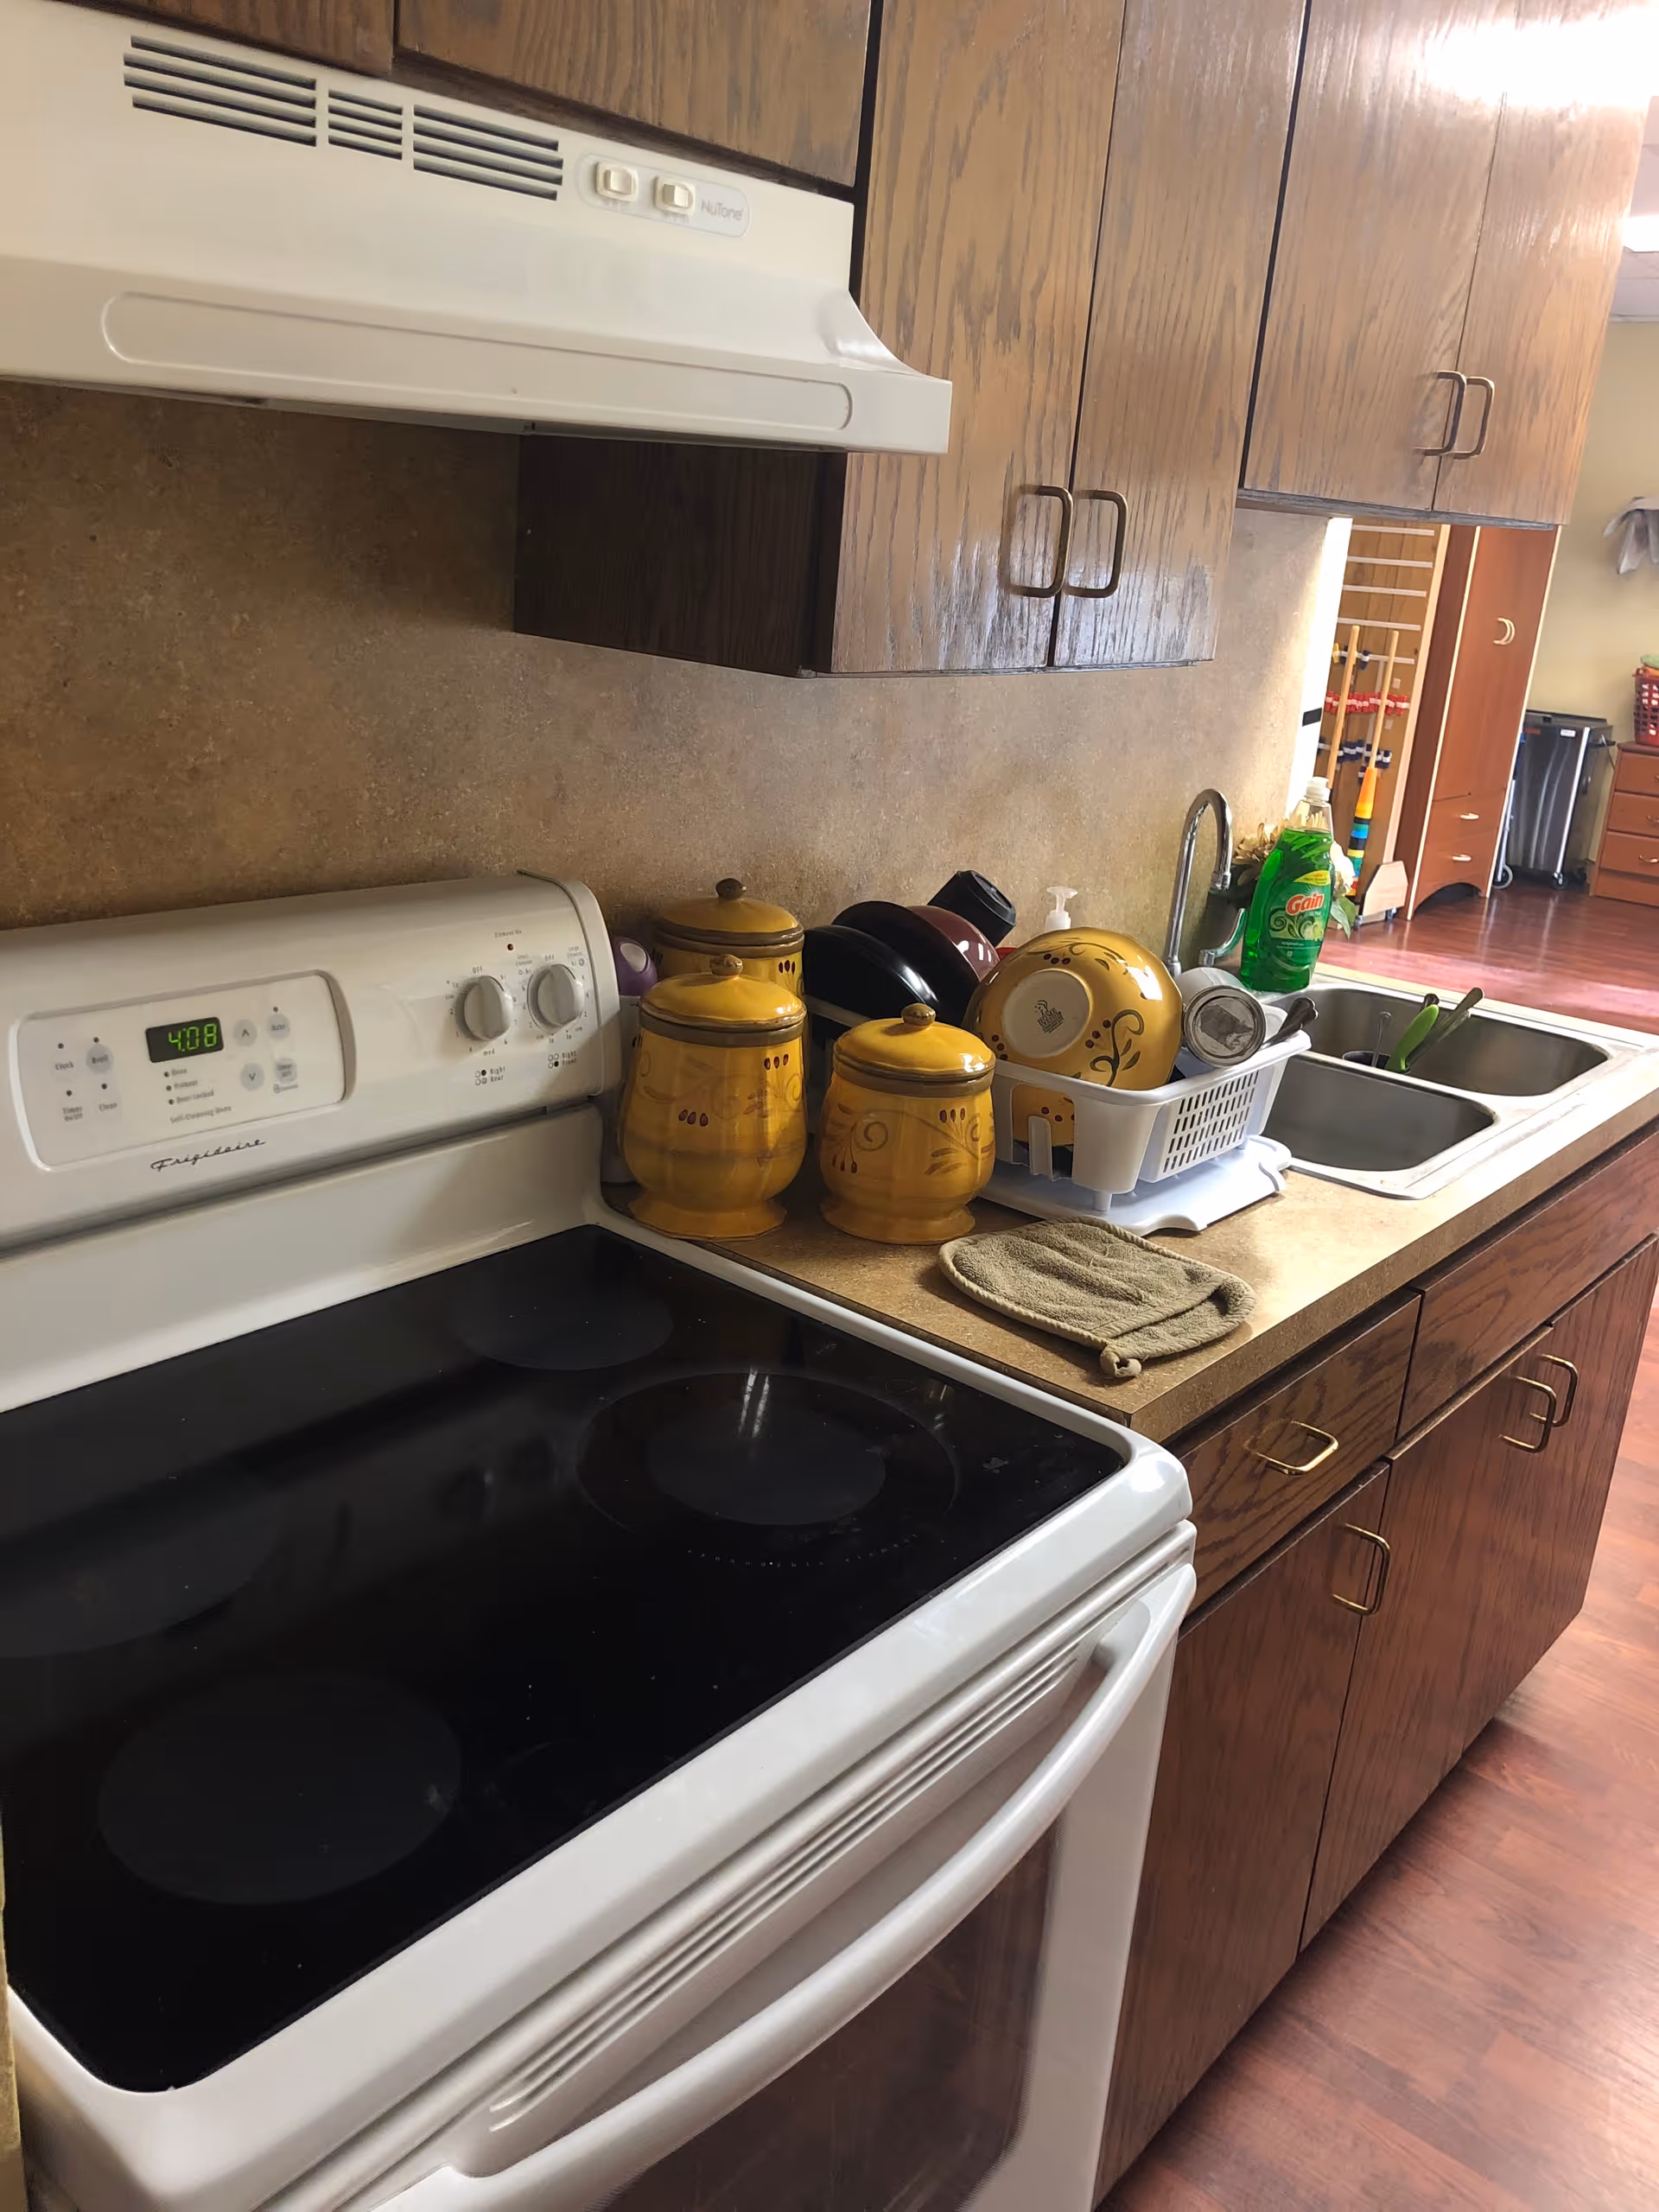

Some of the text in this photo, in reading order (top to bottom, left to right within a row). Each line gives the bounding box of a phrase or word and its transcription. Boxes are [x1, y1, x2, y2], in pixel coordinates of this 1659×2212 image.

[701, 200, 742, 221] NuTone
[1287, 893, 1324, 914] Gain
[168, 1022, 218, 1052] 4:08
[562, 1050, 577, 1059] Right
[490, 1066, 505, 1076] Right
[150, 1139, 266, 1172] Frigidaire
